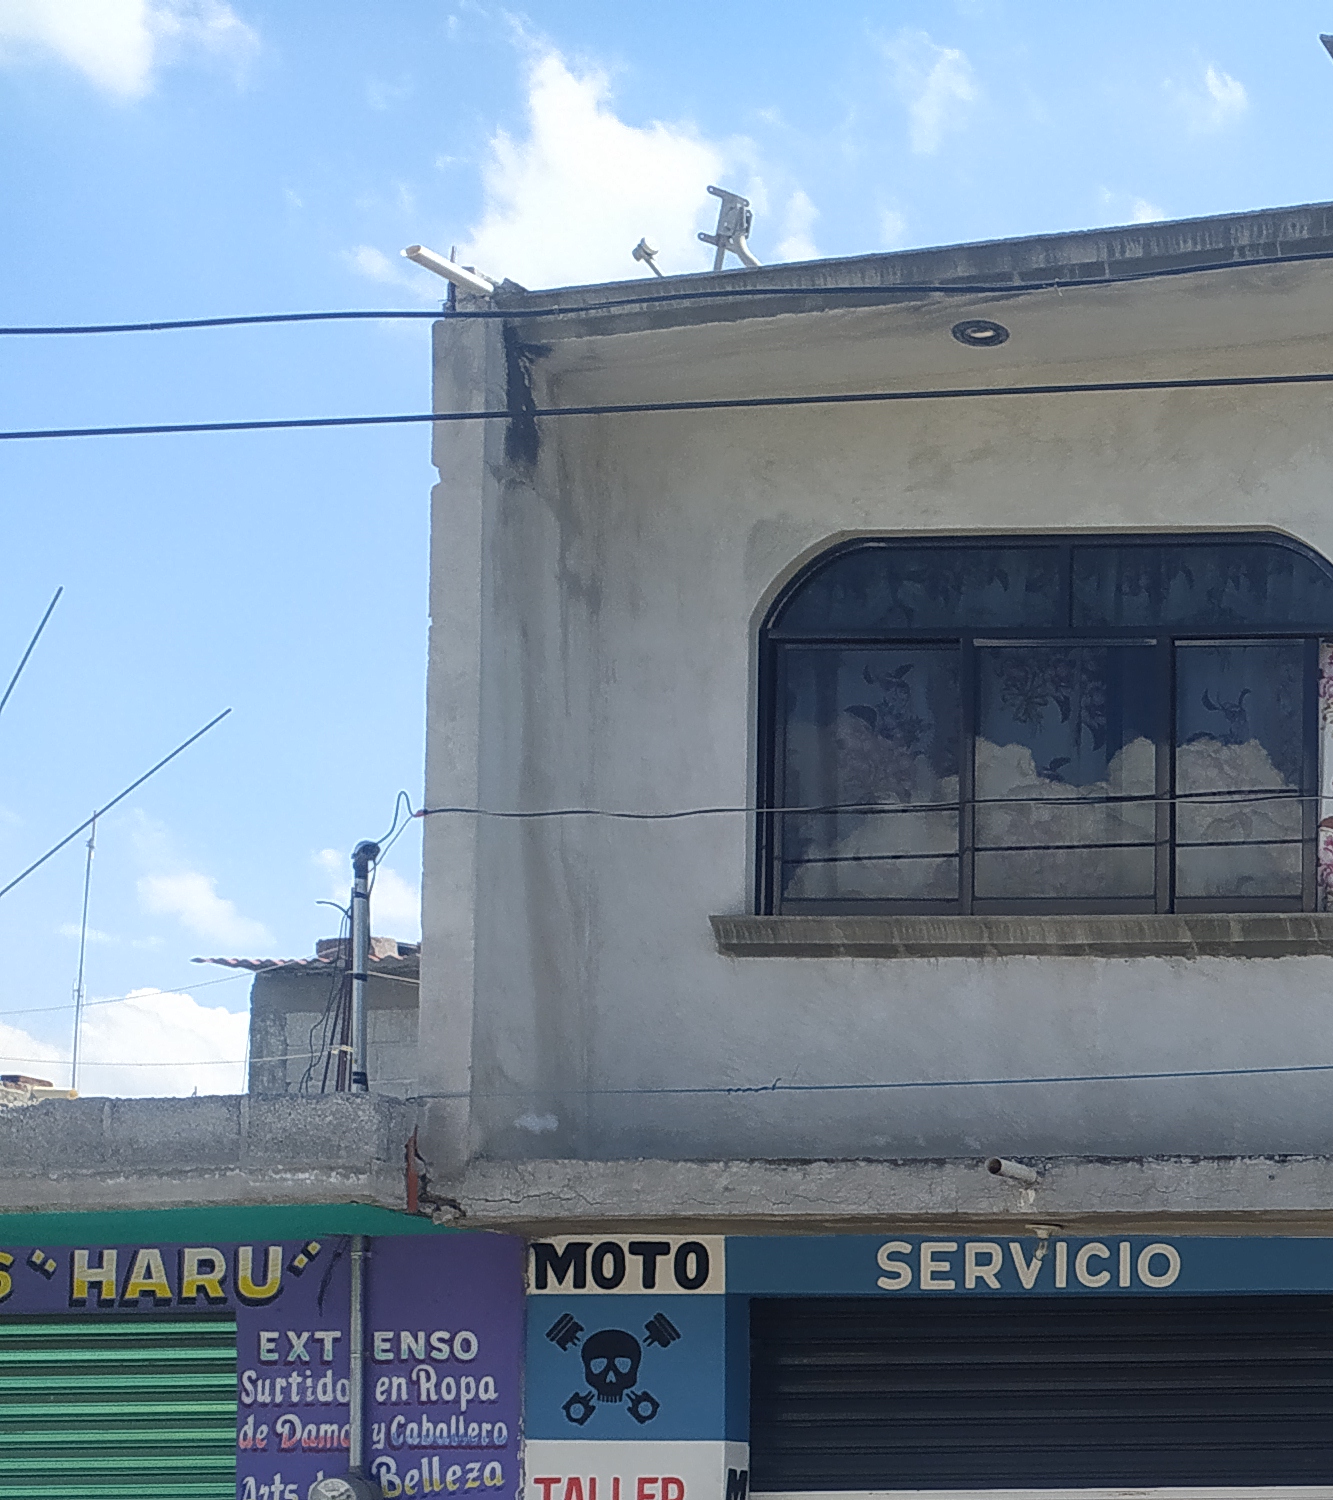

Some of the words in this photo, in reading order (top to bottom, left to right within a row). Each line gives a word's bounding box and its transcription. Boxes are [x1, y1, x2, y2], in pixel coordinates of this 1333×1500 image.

[534, 1241, 710, 1290] MOTO
[876, 1241, 1182, 1290] SERVICIO
[241, 1369, 350, 1404] Surtido
[375, 1375, 408, 1402] en
[412, 1364, 499, 1411] Ropa
[238, 1414, 269, 1449] de
[371, 1423, 386, 1450] y
[391, 1414, 508, 1446] Caballero
[372, 1455, 505, 1499] Belleza
